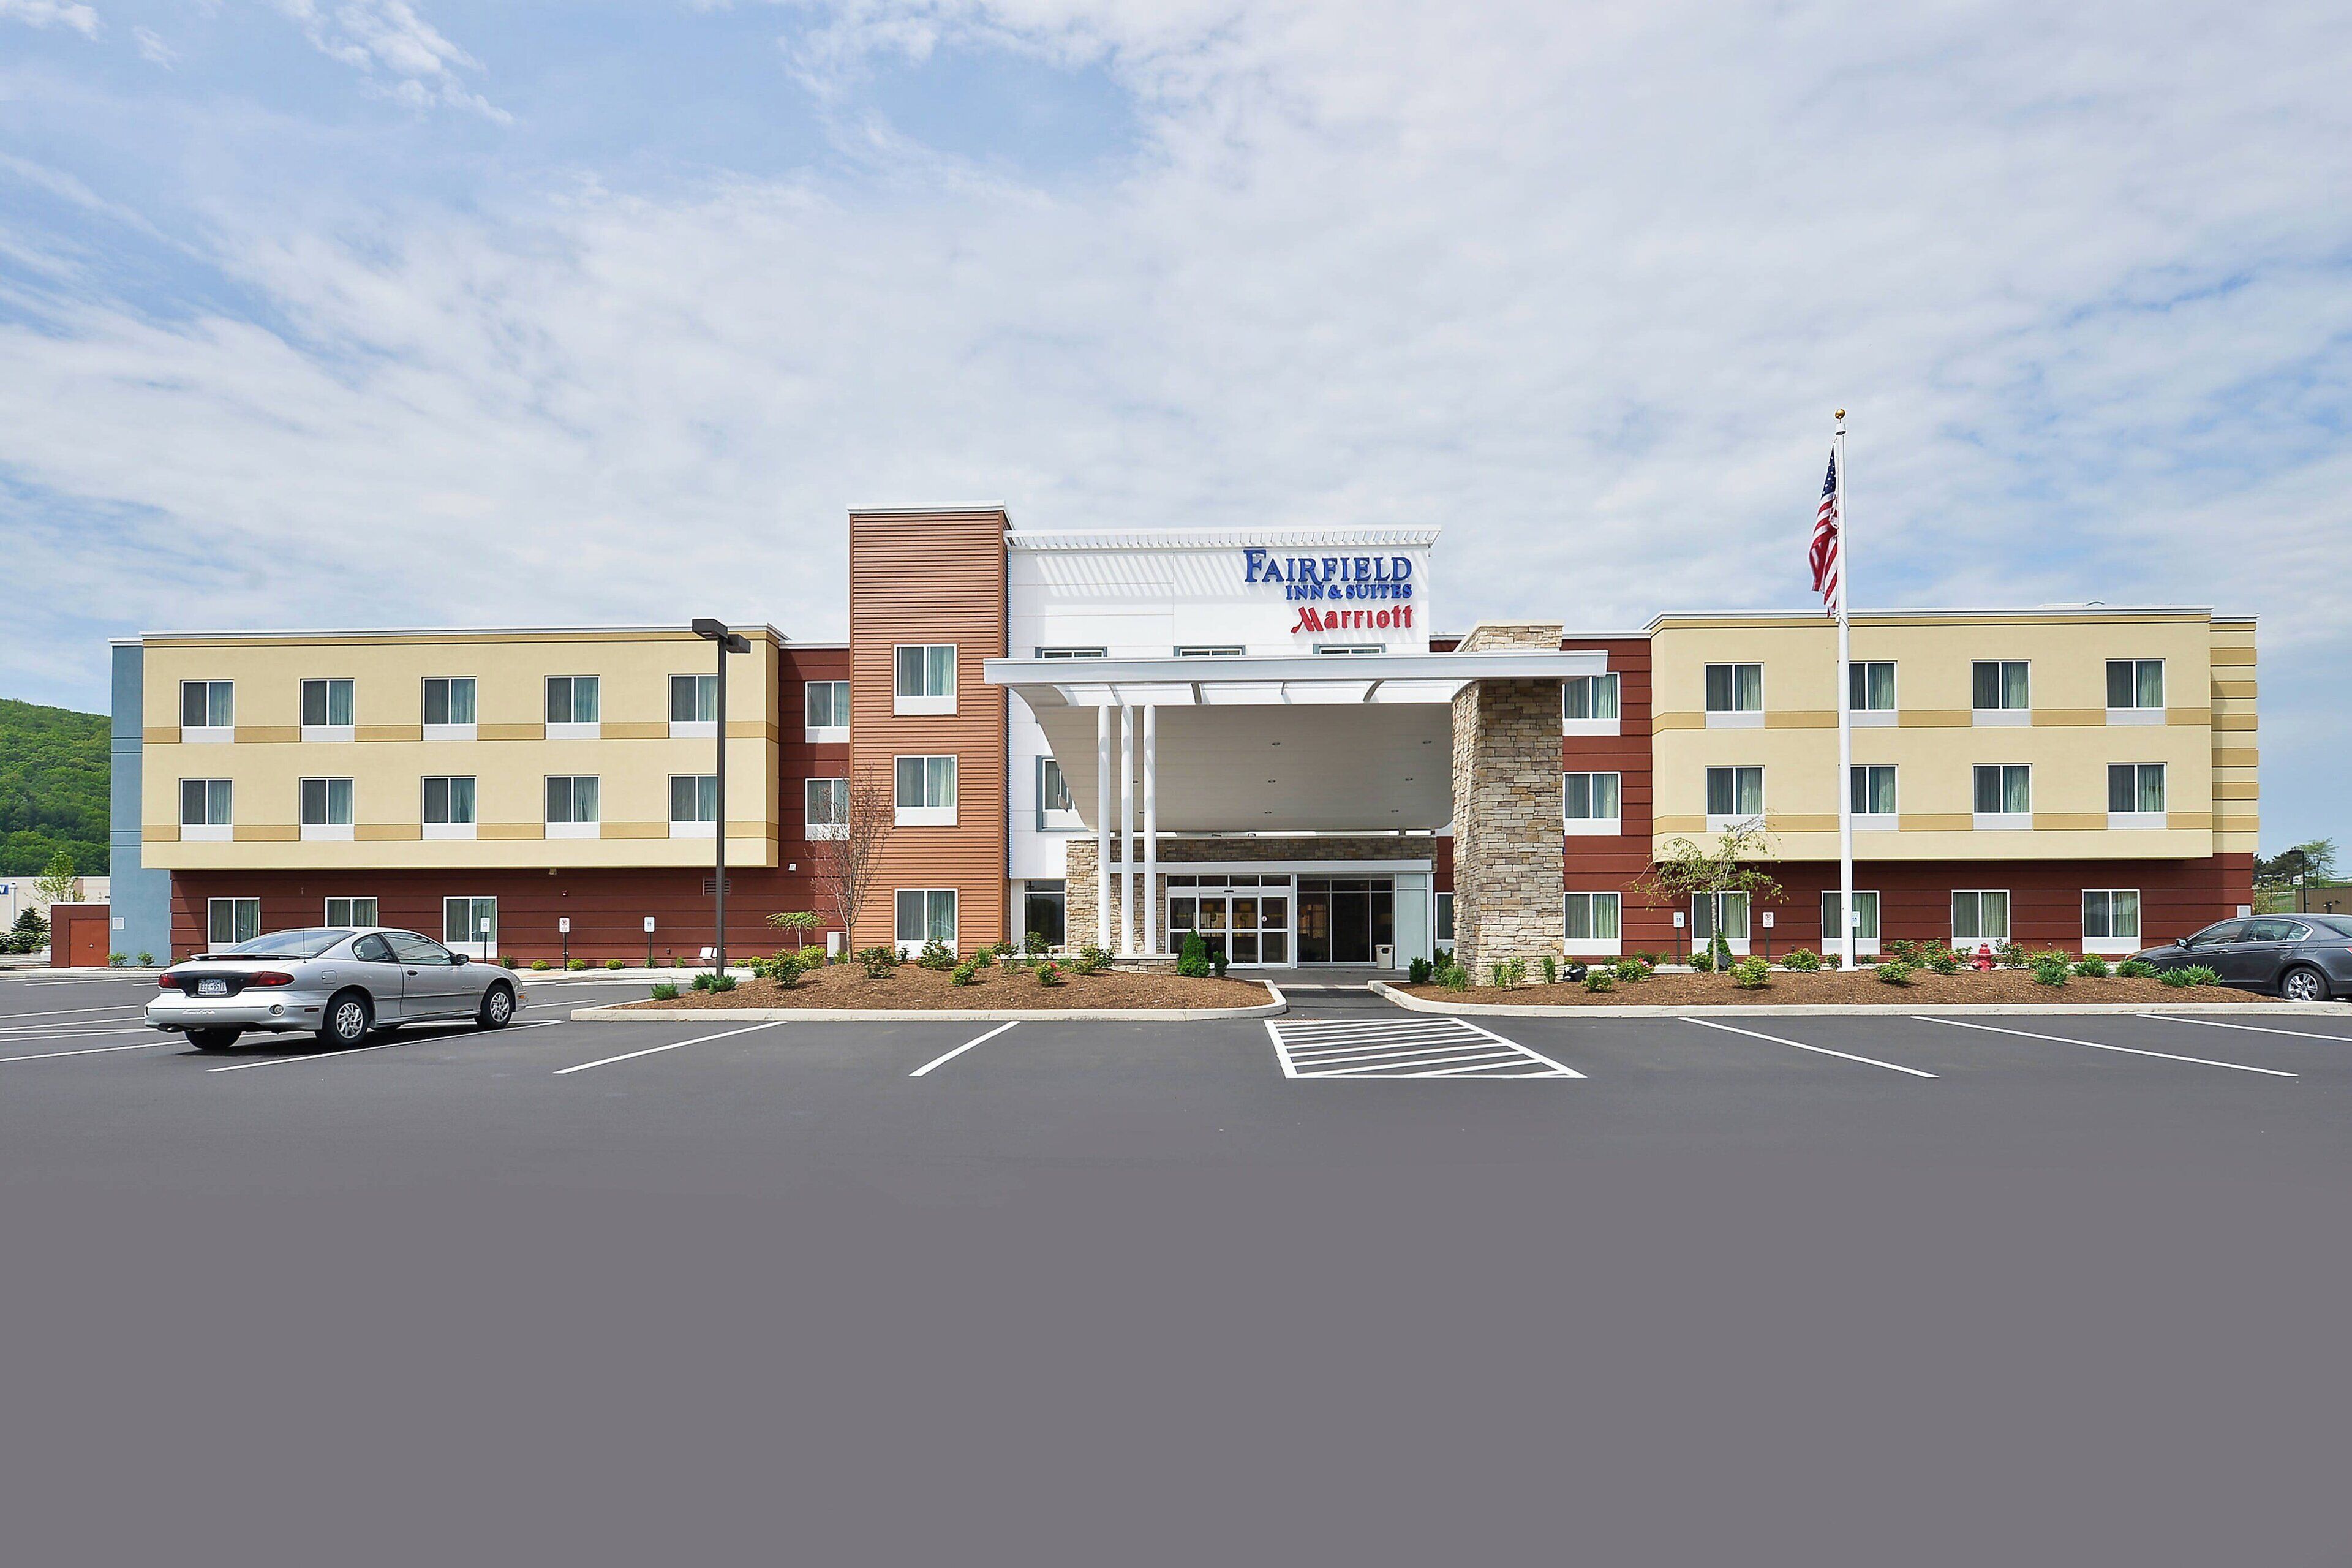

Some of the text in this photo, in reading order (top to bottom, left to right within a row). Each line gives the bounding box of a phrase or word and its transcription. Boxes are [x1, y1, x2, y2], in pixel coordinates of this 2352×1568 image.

[1243, 549, 1412, 584] FAIRFIELD
[1286, 584, 1412, 600] INN & SUITES
[1291, 605, 1412, 633] Marriott
